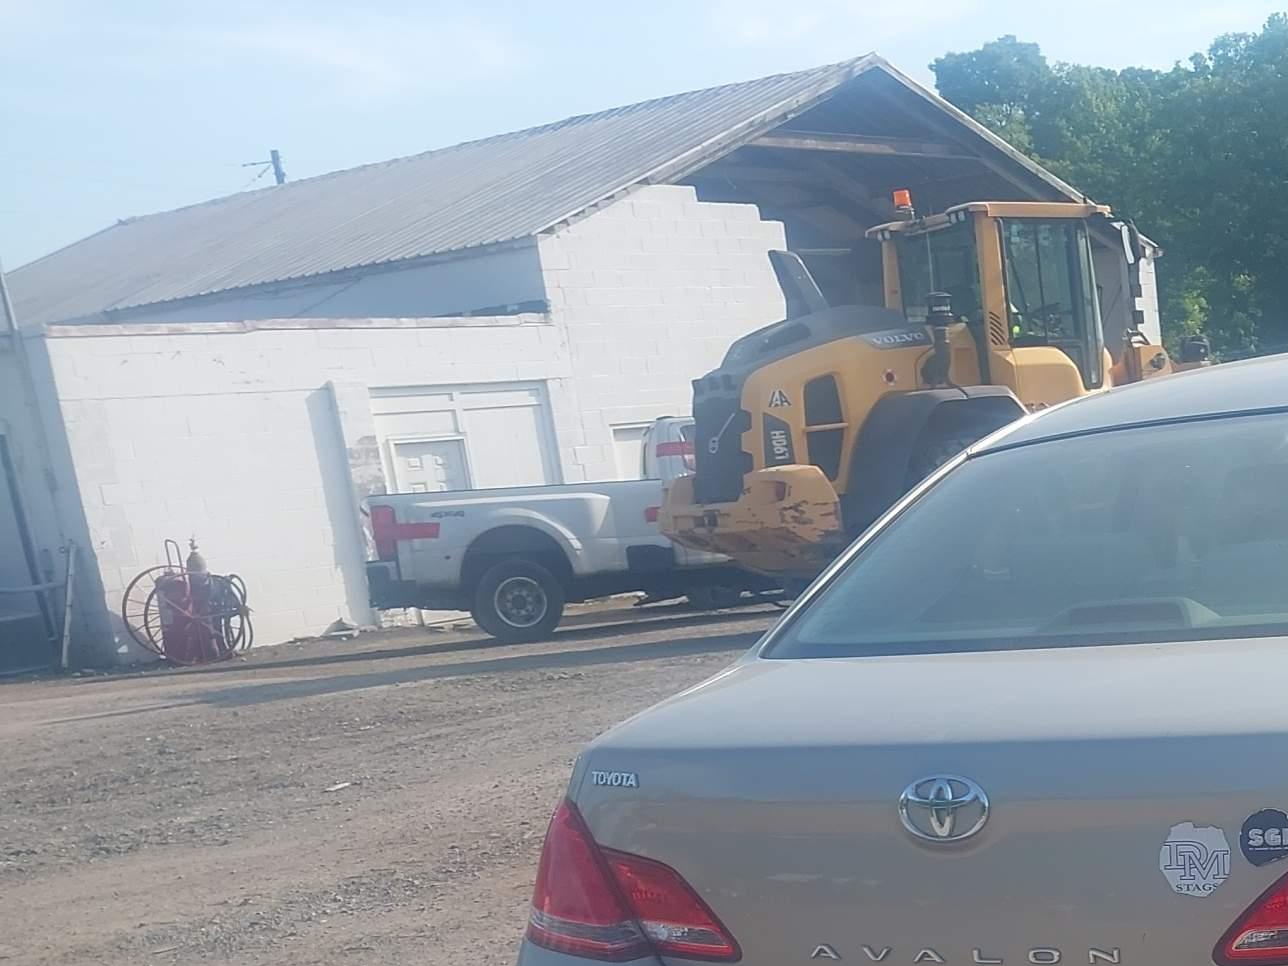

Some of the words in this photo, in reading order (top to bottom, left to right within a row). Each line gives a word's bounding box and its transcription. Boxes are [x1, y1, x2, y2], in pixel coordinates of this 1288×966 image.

[872, 332, 924, 345] VOLVO
[591, 770, 639, 788] TOYOTA
[1163, 840, 1230, 880] DM
[1175, 882, 1218, 892] STAGS
[810, 943, 1121, 965] AVALON
